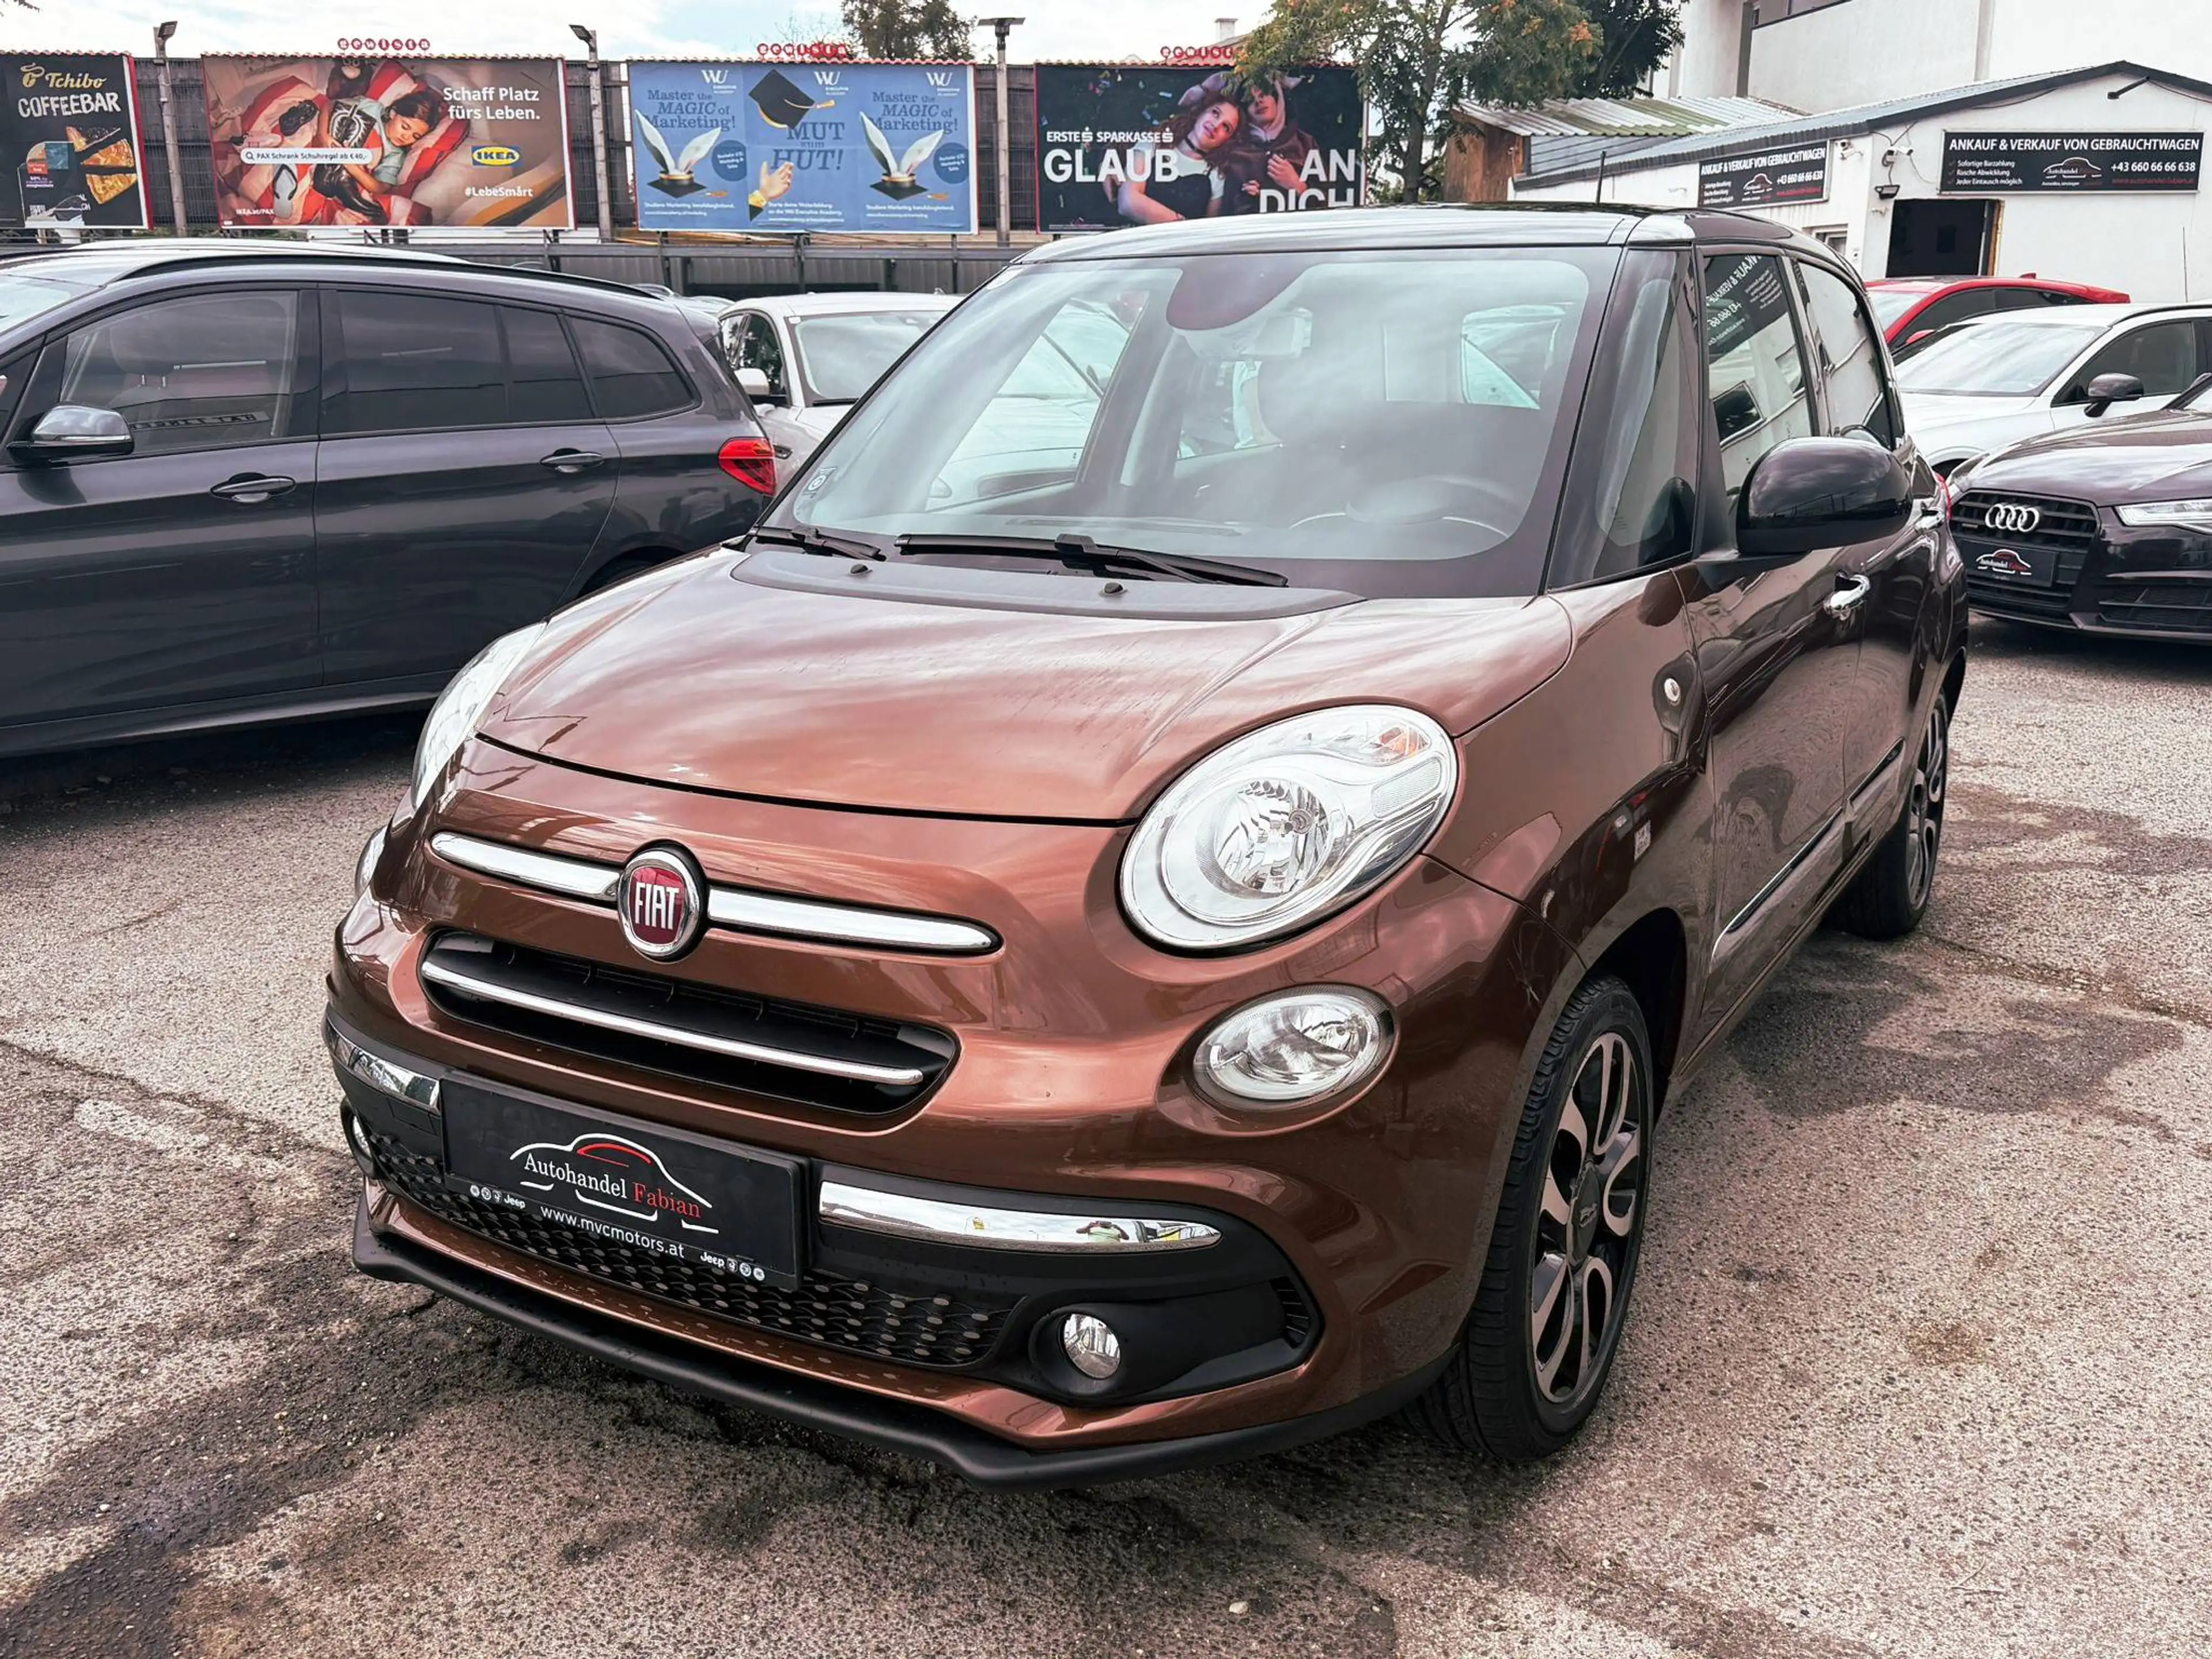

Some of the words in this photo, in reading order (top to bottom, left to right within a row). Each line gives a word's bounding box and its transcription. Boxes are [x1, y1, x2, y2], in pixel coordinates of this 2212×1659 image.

[46, 73, 107, 88] Tchibo
[701, 70, 728, 84] WU
[814, 71, 840, 85] WU
[926, 72, 953, 86] WU
[443, 87, 495, 101] Schaff
[499, 87, 540, 101] Platz
[647, 90, 694, 101] Master
[872, 92, 918, 103] Master
[18, 93, 121, 118] COFFEEBAR
[448, 105, 482, 120] fürs
[486, 105, 540, 120] Leben.
[657, 103, 716, 115] MAGIC
[718, 106, 730, 115] of
[882, 105, 939, 117] MAGIC
[941, 108, 953, 118] of
[646, 116, 735, 132] Marketing!
[787, 122, 844, 140] MUT
[870, 118, 958, 134] Marketing!
[1047, 131, 1080, 142] ERSTE
[1097, 131, 1161, 143] SPARKASSE
[1949, 139, 1998, 151] ANKAUF
[1999, 139, 2008, 150] &
[2010, 139, 2062, 151] VERKAUF
[2063, 139, 2088, 150] VON
[2091, 139, 2199, 151] GEBRAUCHTWAGEN
[301, 152, 338, 160] Schuhregal
[477, 151, 516, 160] IKEA
[770, 149, 844, 170] HUT!
[1701, 162, 1723, 176] ANKAUF
[1729, 158, 1753, 172] VERKAUF
[1754, 156, 1767, 168] VON
[1768, 147, 1825, 166] GEBRAUCHTWAGEN
[1044, 149, 1180, 183] GLAUB
[1299, 149, 1355, 181] AN
[2111, 162, 2128, 172] +43
[2131, 162, 2149, 172] 660
[2151, 162, 2162, 172] 66
[2165, 162, 2176, 172] 66
[2178, 162, 2195, 172] 638
[1260, 188, 1354, 213] DICH
[635, 881, 680, 930] FIAT
[524, 1153, 627, 1199] Autohandel
[632, 1181, 701, 1218] Fabian
[504, 1194, 525, 1209] Jeep
[540, 1206, 684, 1259] www.mvcmotors.at
[700, 1252, 725, 1267] Jeep
